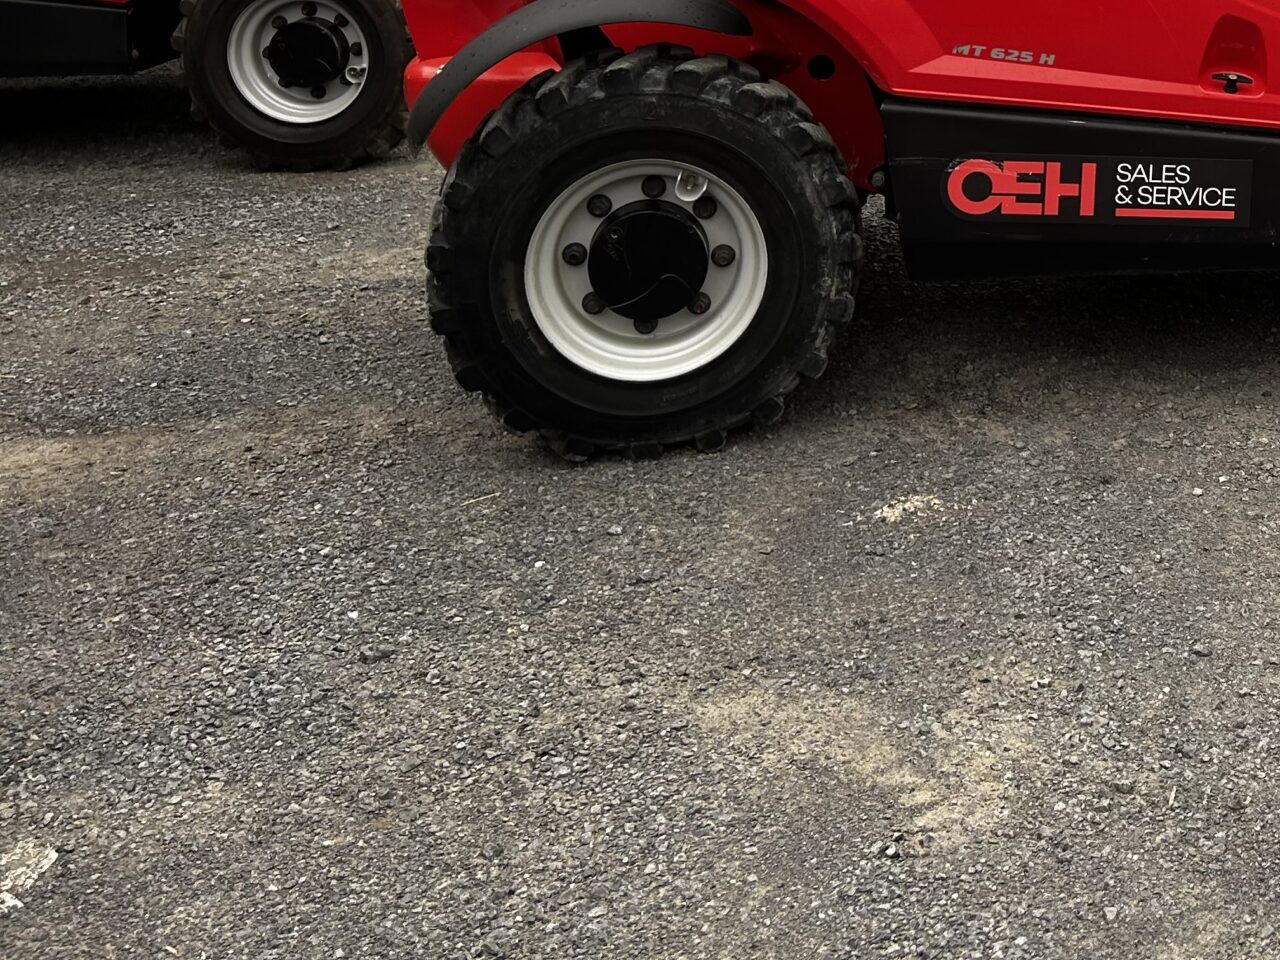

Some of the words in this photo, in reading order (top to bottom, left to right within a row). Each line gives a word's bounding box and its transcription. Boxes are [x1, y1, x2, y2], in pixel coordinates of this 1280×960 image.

[952, 44, 987, 57] MT
[990, 47, 1033, 63] 625
[1039, 52, 1056, 65] H
[1116, 163, 1190, 184] SALES
[947, 158, 1097, 216] OEH
[1115, 185, 1132, 205] &
[1137, 186, 1236, 207] SERVICE
